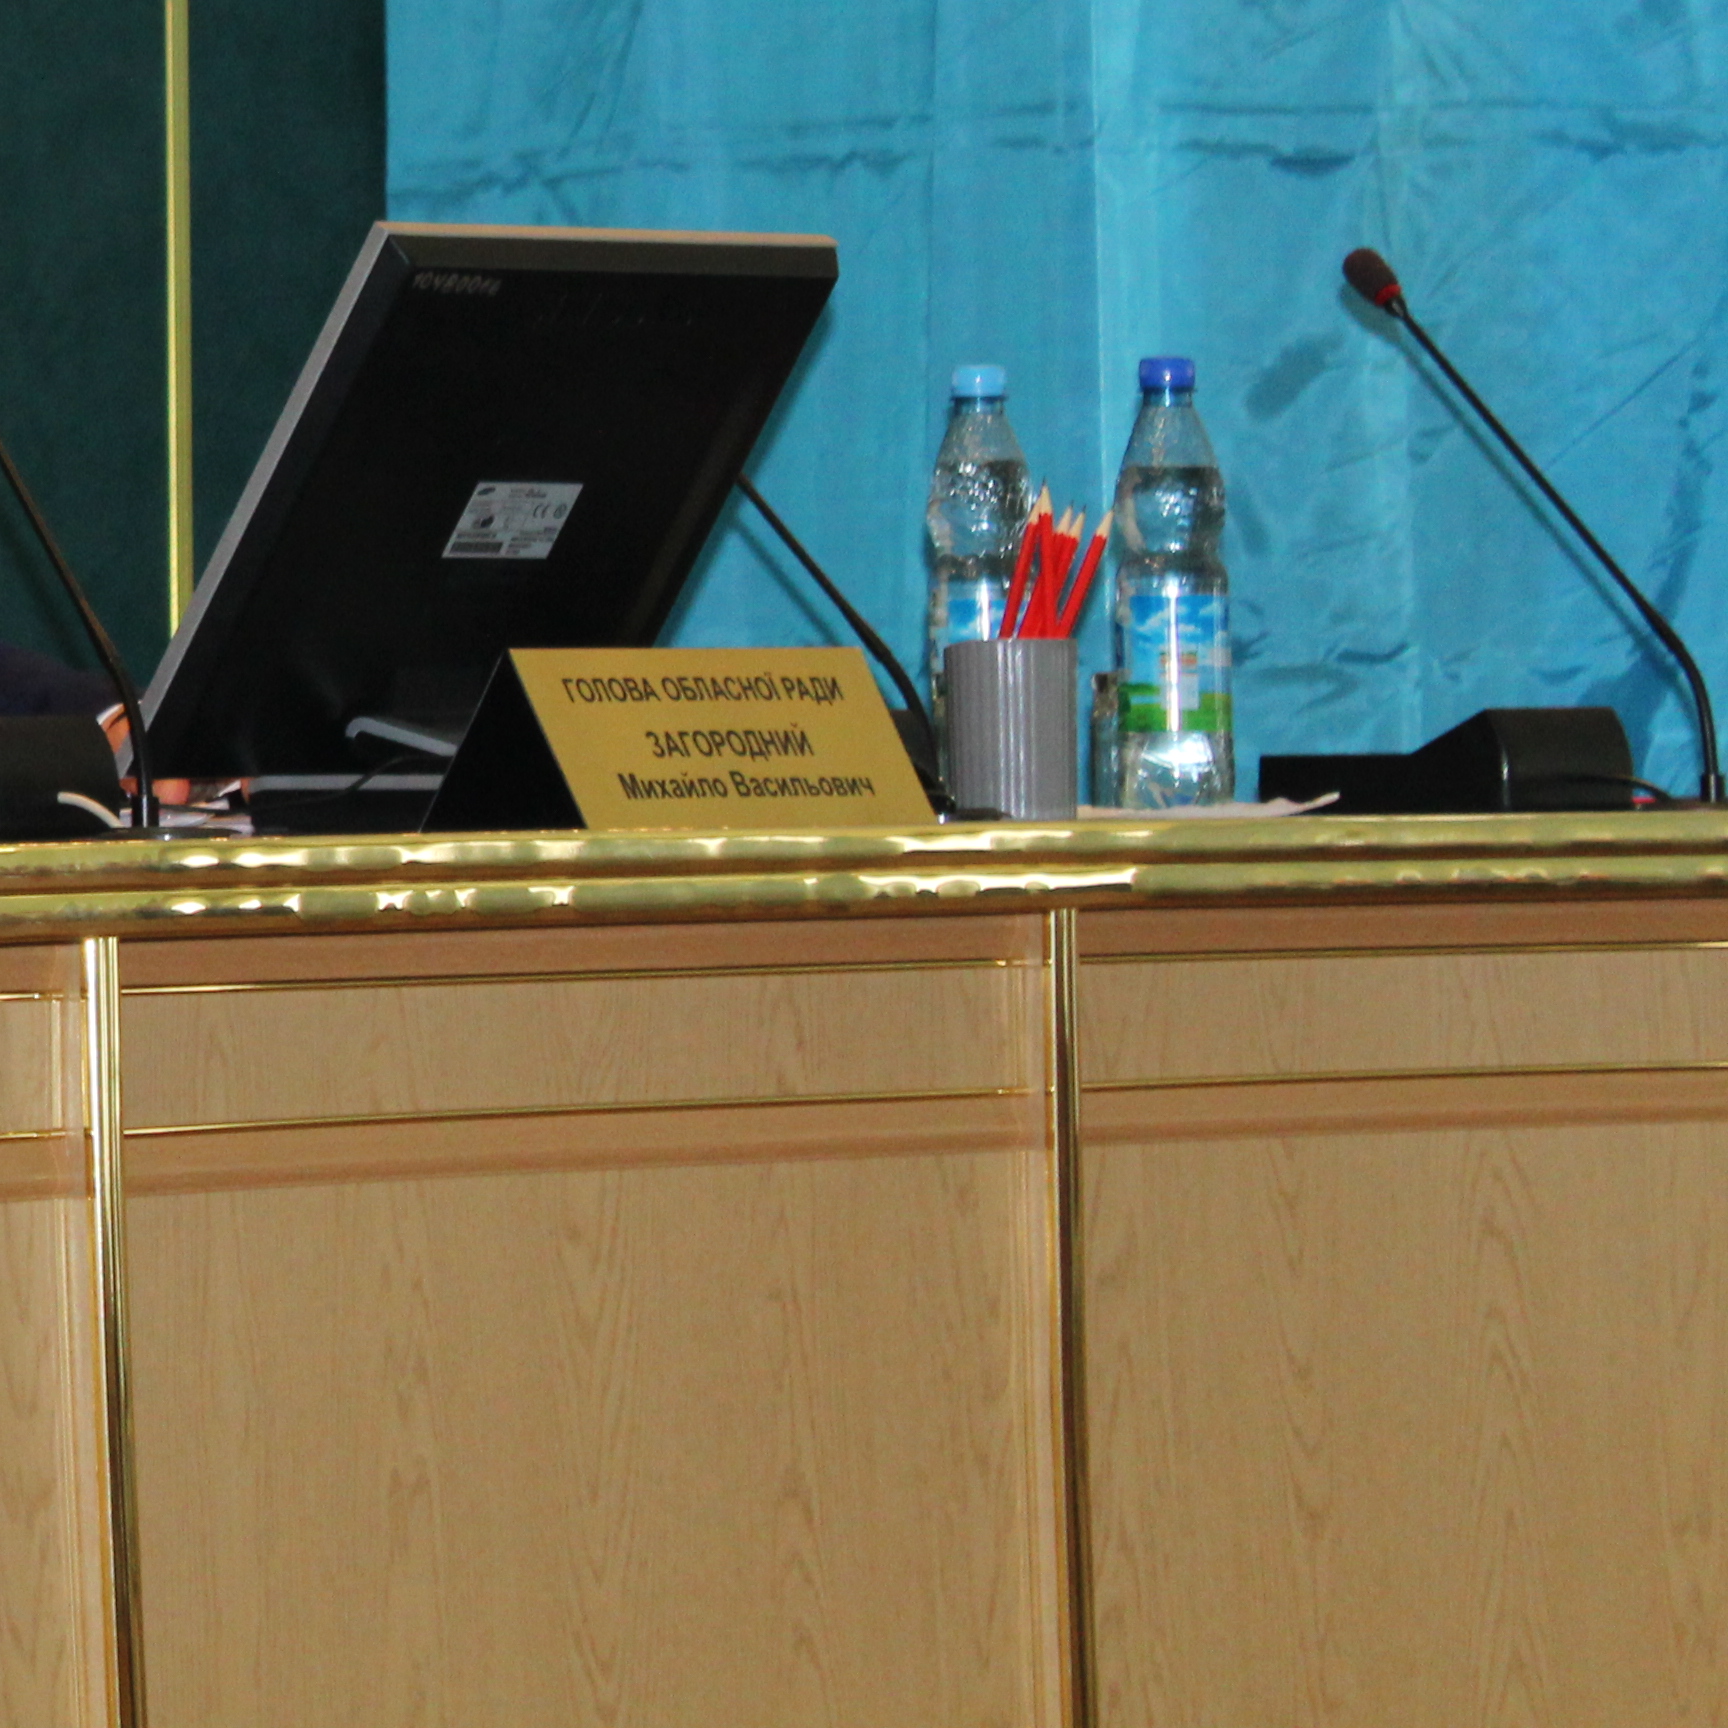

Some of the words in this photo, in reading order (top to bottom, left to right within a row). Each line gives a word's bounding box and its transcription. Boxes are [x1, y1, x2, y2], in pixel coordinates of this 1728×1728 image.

[561, 677, 661, 703] ГОЛОВА
[661, 672, 782, 703] ОБЛАСНОЇ
[781, 676, 845, 706] РАДИ
[645, 722, 815, 762] ЗАГОРОДНИЙ
[617, 772, 728, 800] Михайло
[729, 770, 876, 798] Васильович
